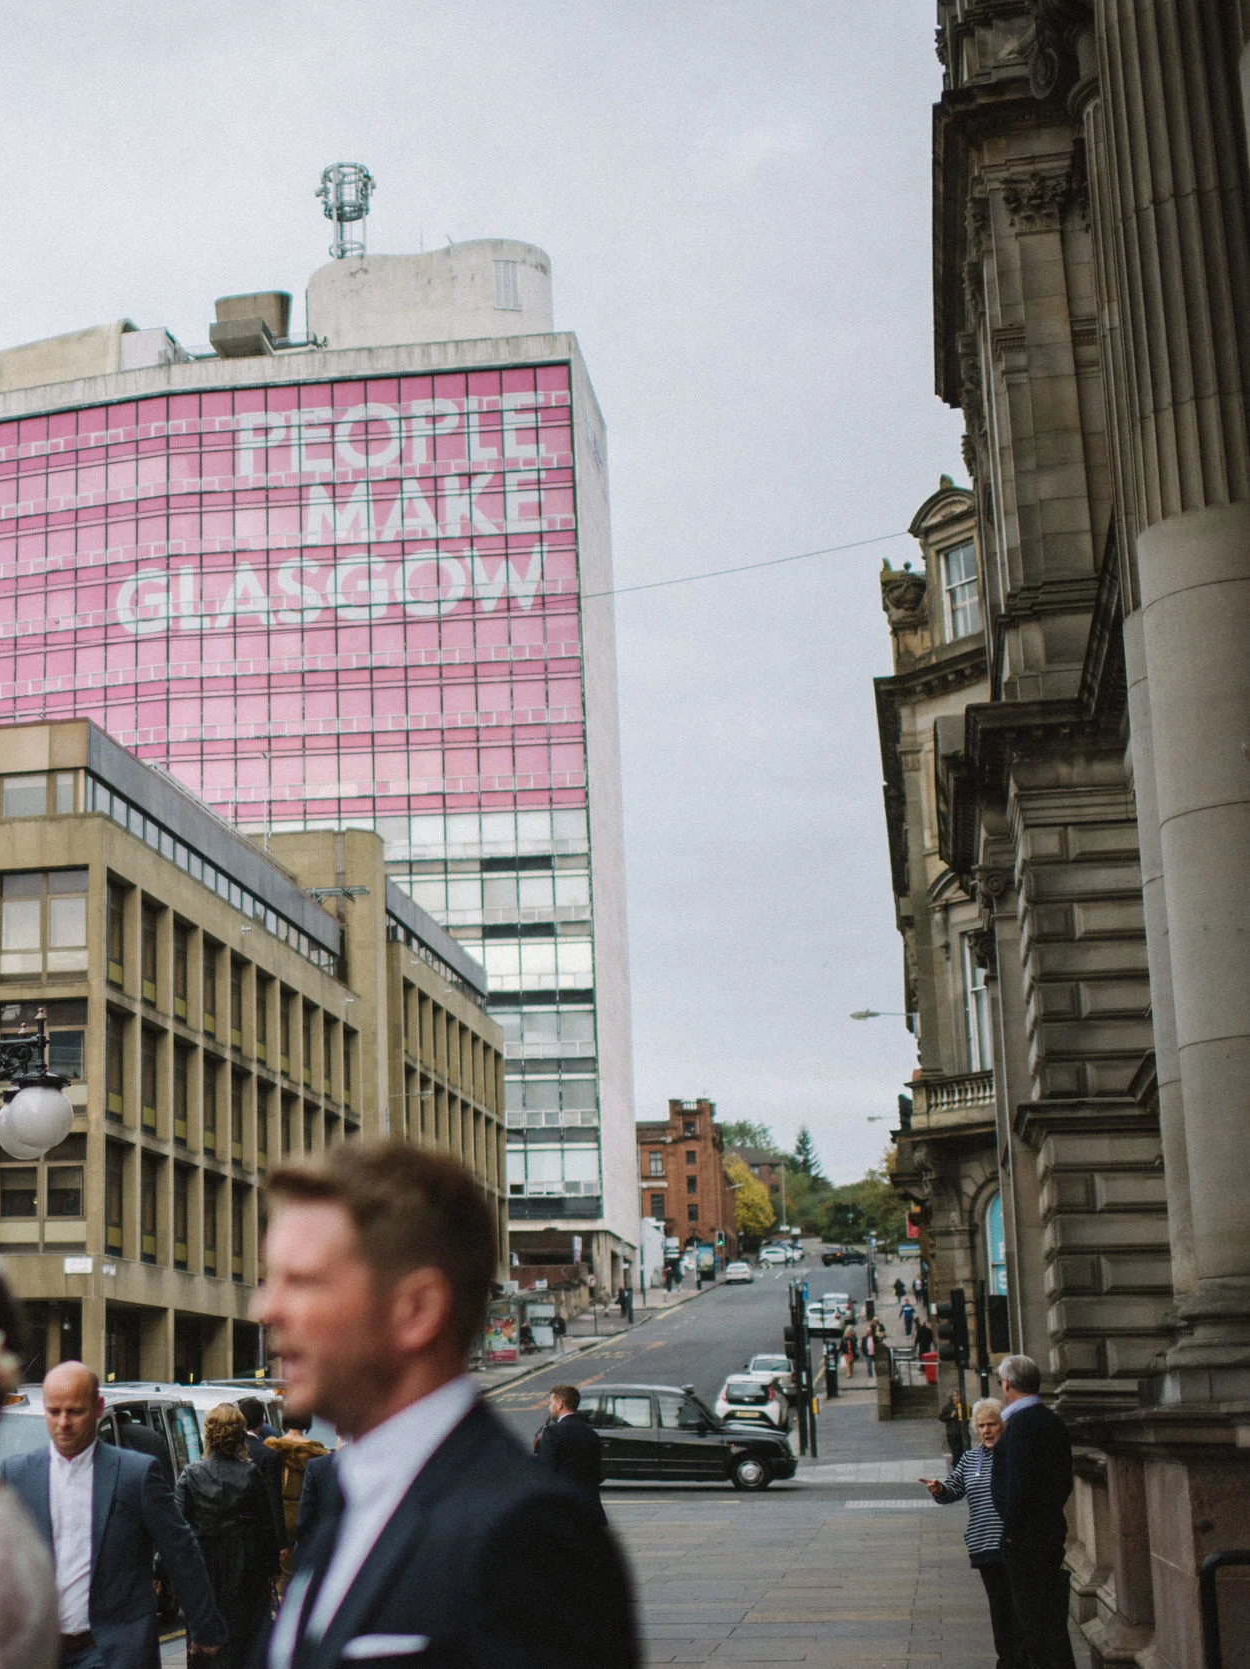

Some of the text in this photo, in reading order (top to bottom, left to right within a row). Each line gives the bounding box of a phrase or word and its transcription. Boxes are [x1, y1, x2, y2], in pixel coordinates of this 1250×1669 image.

[239, 392, 546, 476] PEOPLE
[306, 469, 549, 545] MAKE
[116, 542, 549, 635] GLASGOW
